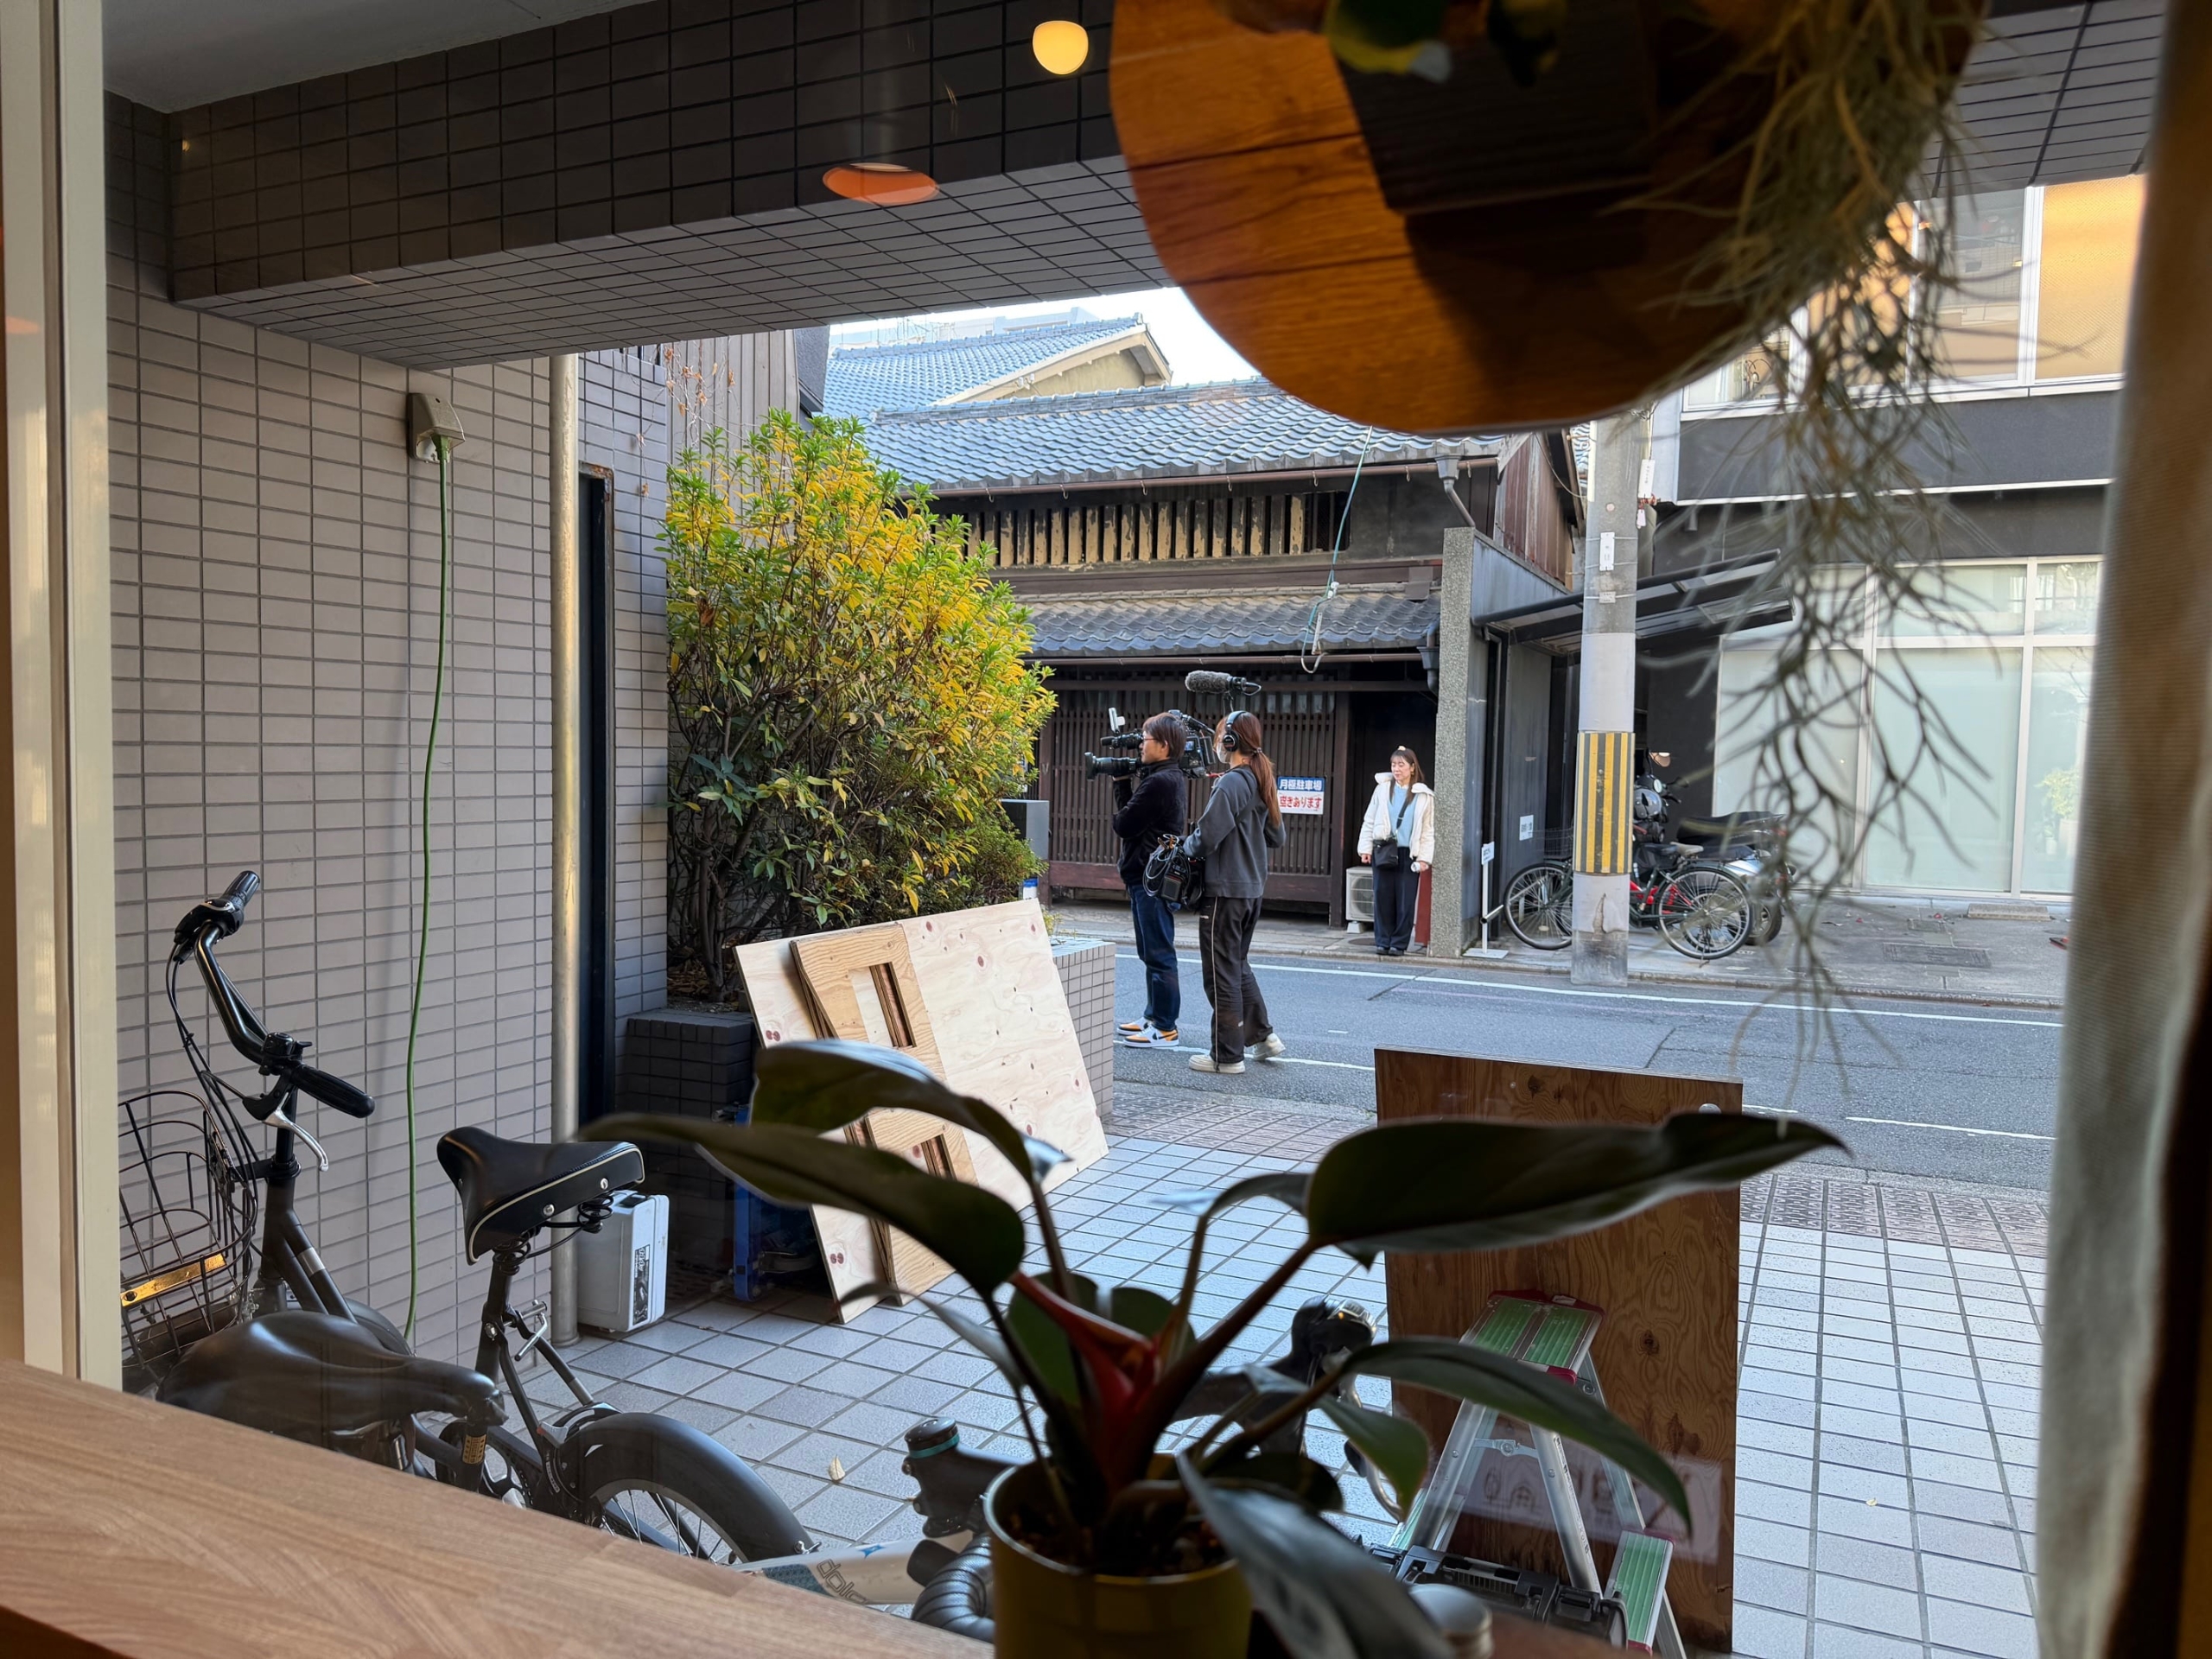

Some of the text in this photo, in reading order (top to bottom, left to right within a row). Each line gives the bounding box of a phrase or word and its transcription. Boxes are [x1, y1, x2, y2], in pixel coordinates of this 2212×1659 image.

[1279, 796, 1322, 809] 空きあります
